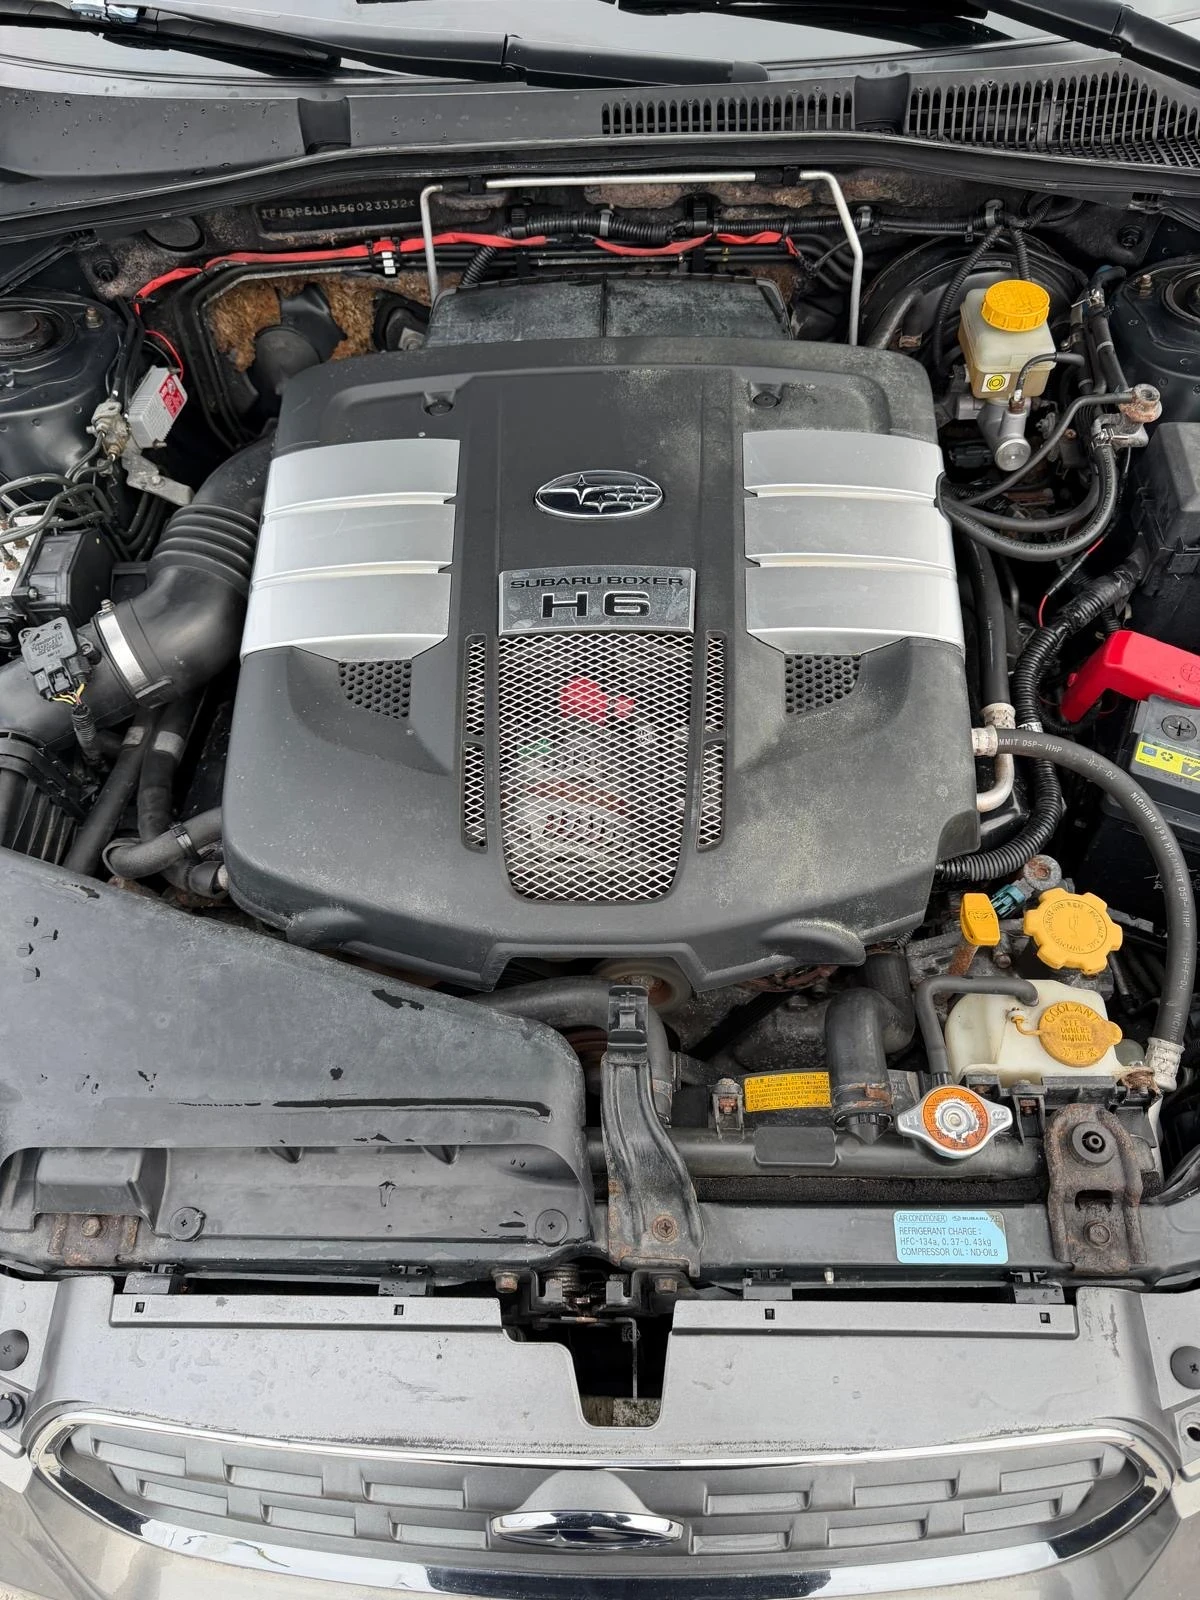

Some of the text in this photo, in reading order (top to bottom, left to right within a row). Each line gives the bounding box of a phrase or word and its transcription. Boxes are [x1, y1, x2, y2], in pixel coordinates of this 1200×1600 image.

[510, 576, 684, 589] SUBARU BOXER
[1130, 791, 1158, 823] NICHIRIN
[1044, 1003, 1101, 1024] COOLANT
[908, 1214, 945, 1222] CONDITIONER
[899, 1226, 947, 1236] REFRIGERANT
[901, 1247, 950, 1257] COMPRESSOR
